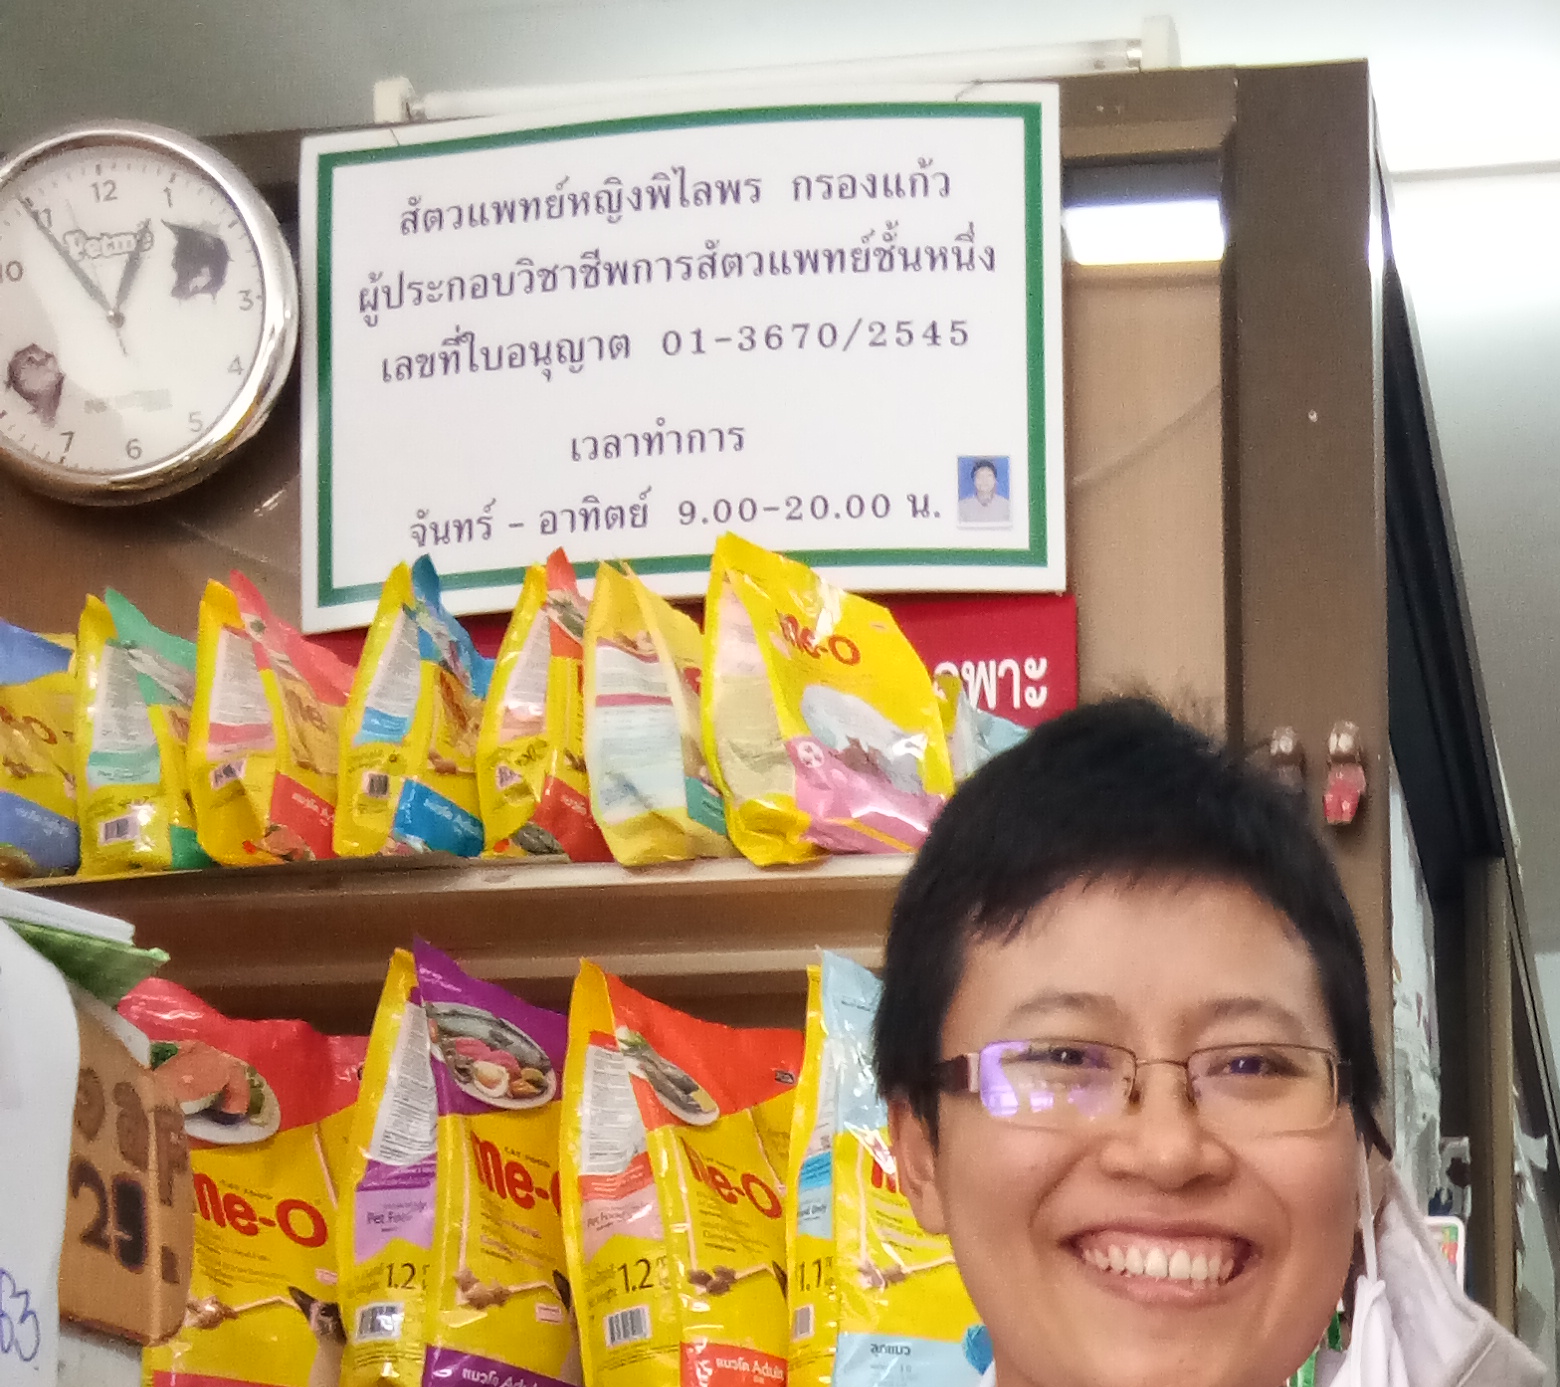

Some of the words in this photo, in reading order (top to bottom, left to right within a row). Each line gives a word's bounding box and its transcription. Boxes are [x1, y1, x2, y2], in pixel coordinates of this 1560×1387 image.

[91, 179, 118, 203] 12
[163, 186, 174, 208] 1
[399, 165, 762, 236] สัตวแพทย์หญิงพิไลพร
[791, 156, 952, 202] กรองแก้ว
[358, 220, 996, 328] ผู้ประกอบวิชาชีพการสัตวแพทย์ชั้นหนึ่ง
[238, 289, 255, 312] 3
[381, 324, 632, 382] เลขที่ใบอนุญาต
[661, 317, 970, 356] 01-3670/2545
[227, 355, 244, 376] 4
[188, 410, 203, 433] 5
[60, 430, 76, 453] 7
[125, 437, 144, 459] 6
[571, 416, 746, 462] เวลาทำการ
[409, 498, 496, 548] จันทร์
[539, 485, 652, 536] อาทิตย์
[678, 493, 891, 526] 9.00-20.00
[906, 493, 941, 519] น.
[387, 1262, 417, 1291] 1.2
[617, 1258, 655, 1294] 1.2
